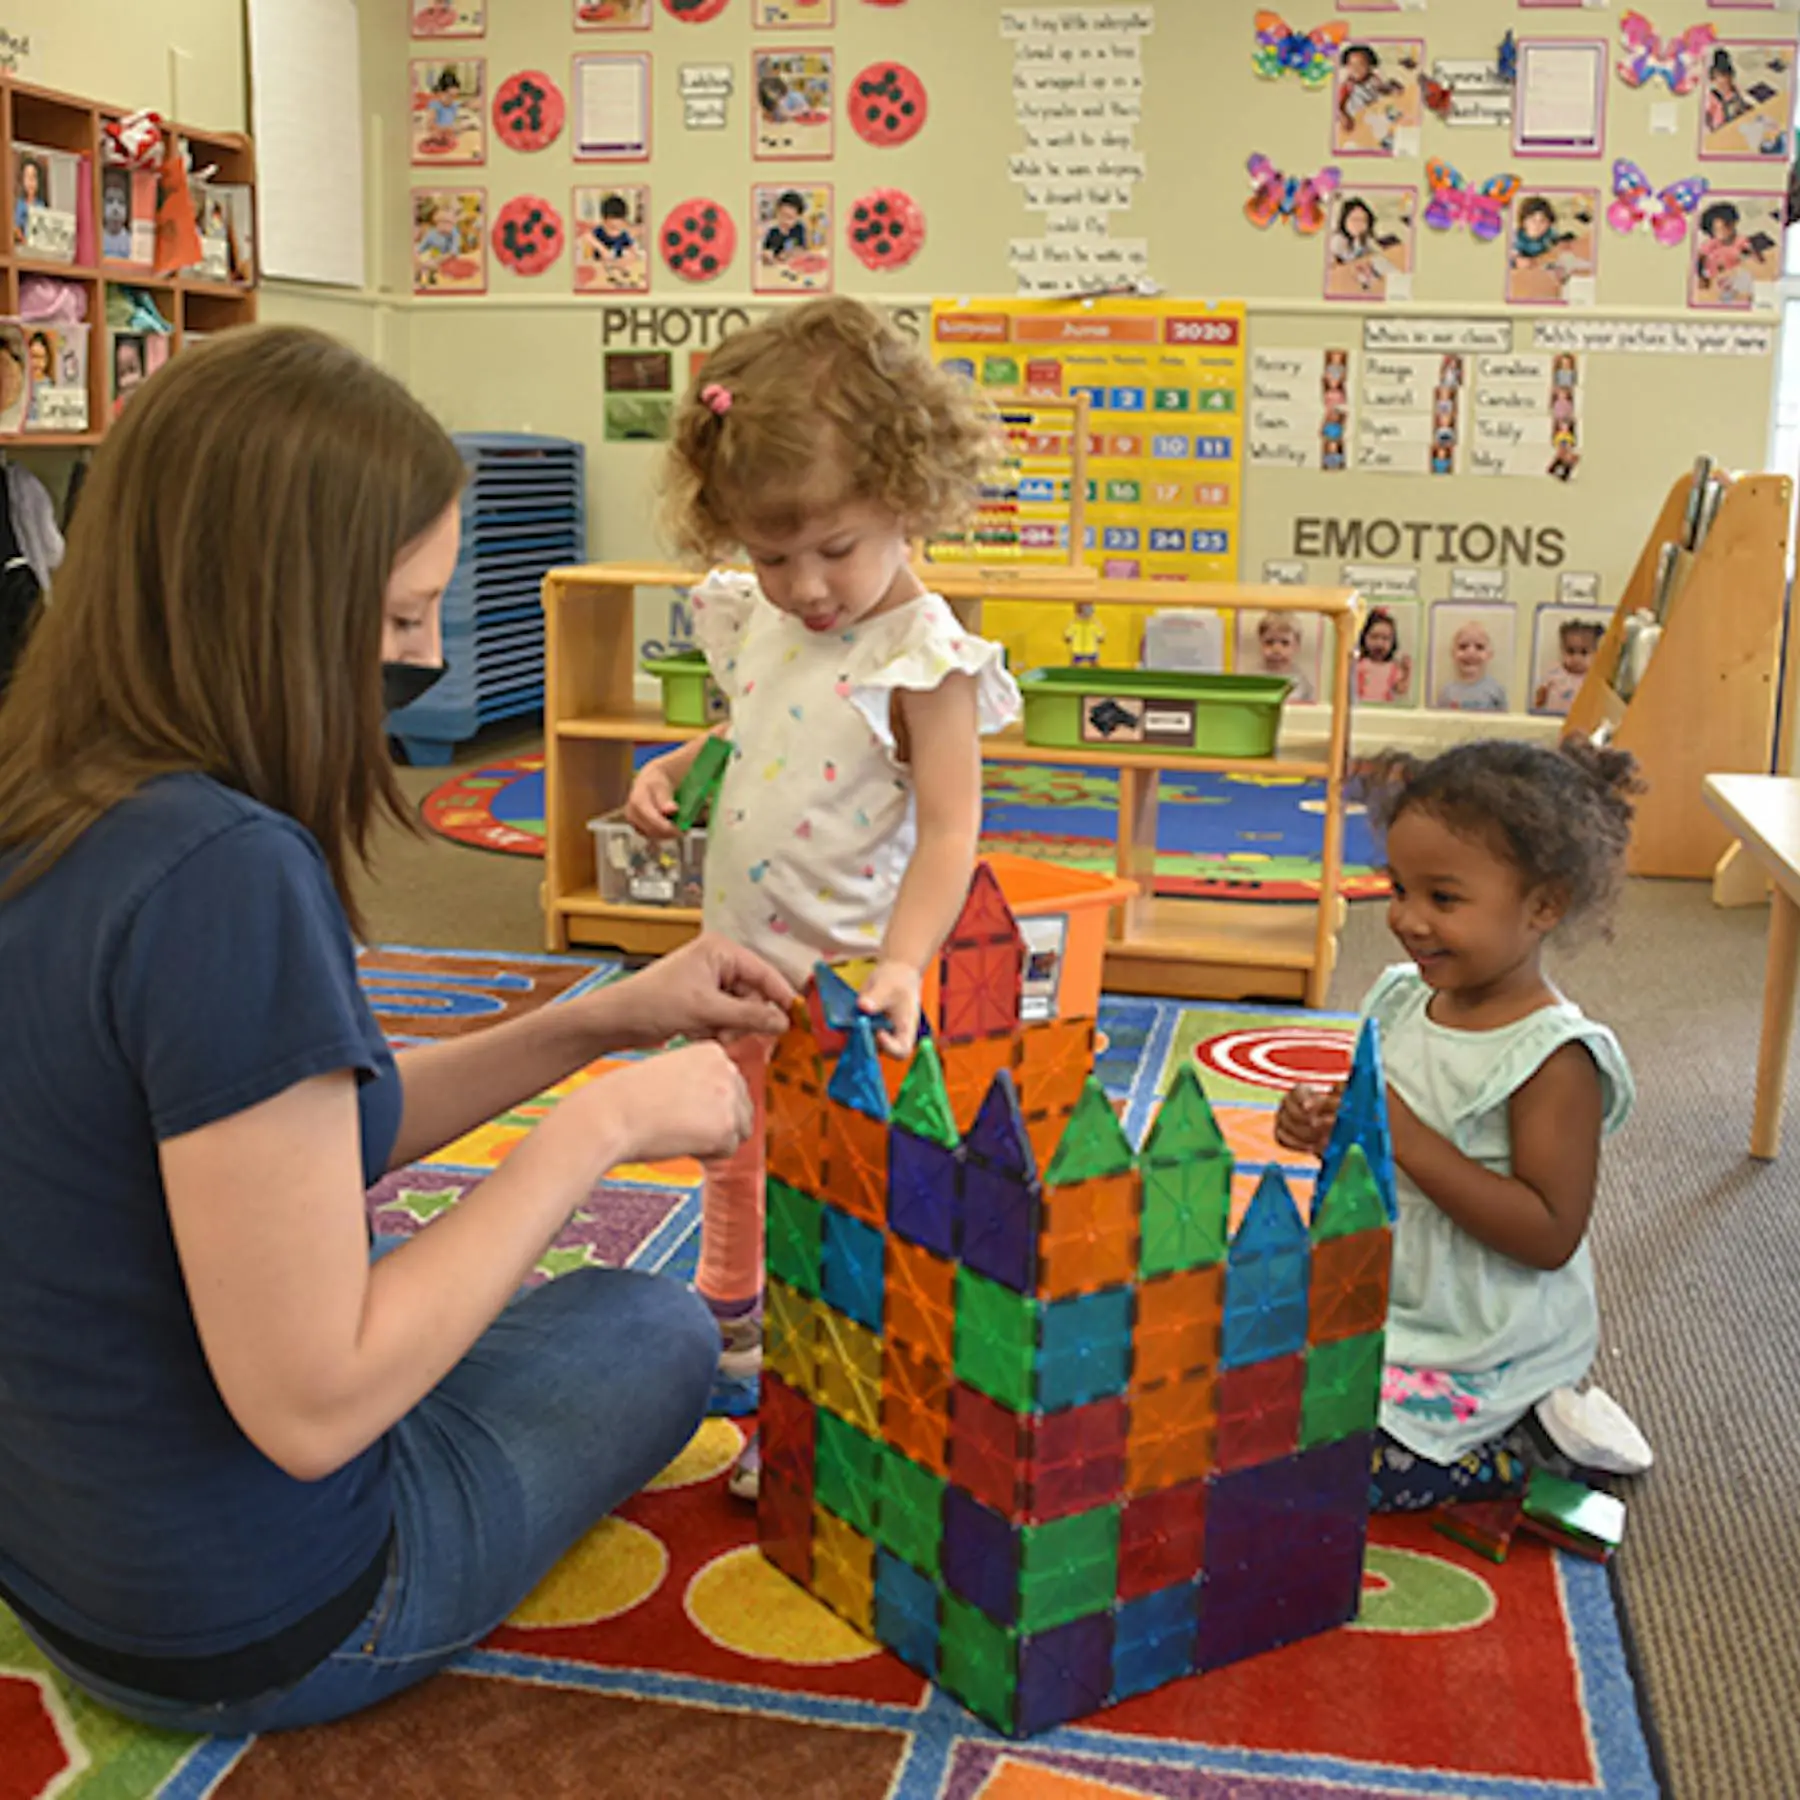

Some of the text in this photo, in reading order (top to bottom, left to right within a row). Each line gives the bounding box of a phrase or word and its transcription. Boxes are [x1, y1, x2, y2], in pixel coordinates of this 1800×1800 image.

[1173, 322, 1233, 342] 2020
[1165, 391, 1180, 409] 3
[1160, 437, 1186, 456] 10
[1202, 438, 1224, 456] 11
[1155, 484, 1179, 501] 17
[1155, 531, 1183, 549] 24
[1293, 516, 1566, 567] EMOTIONS
